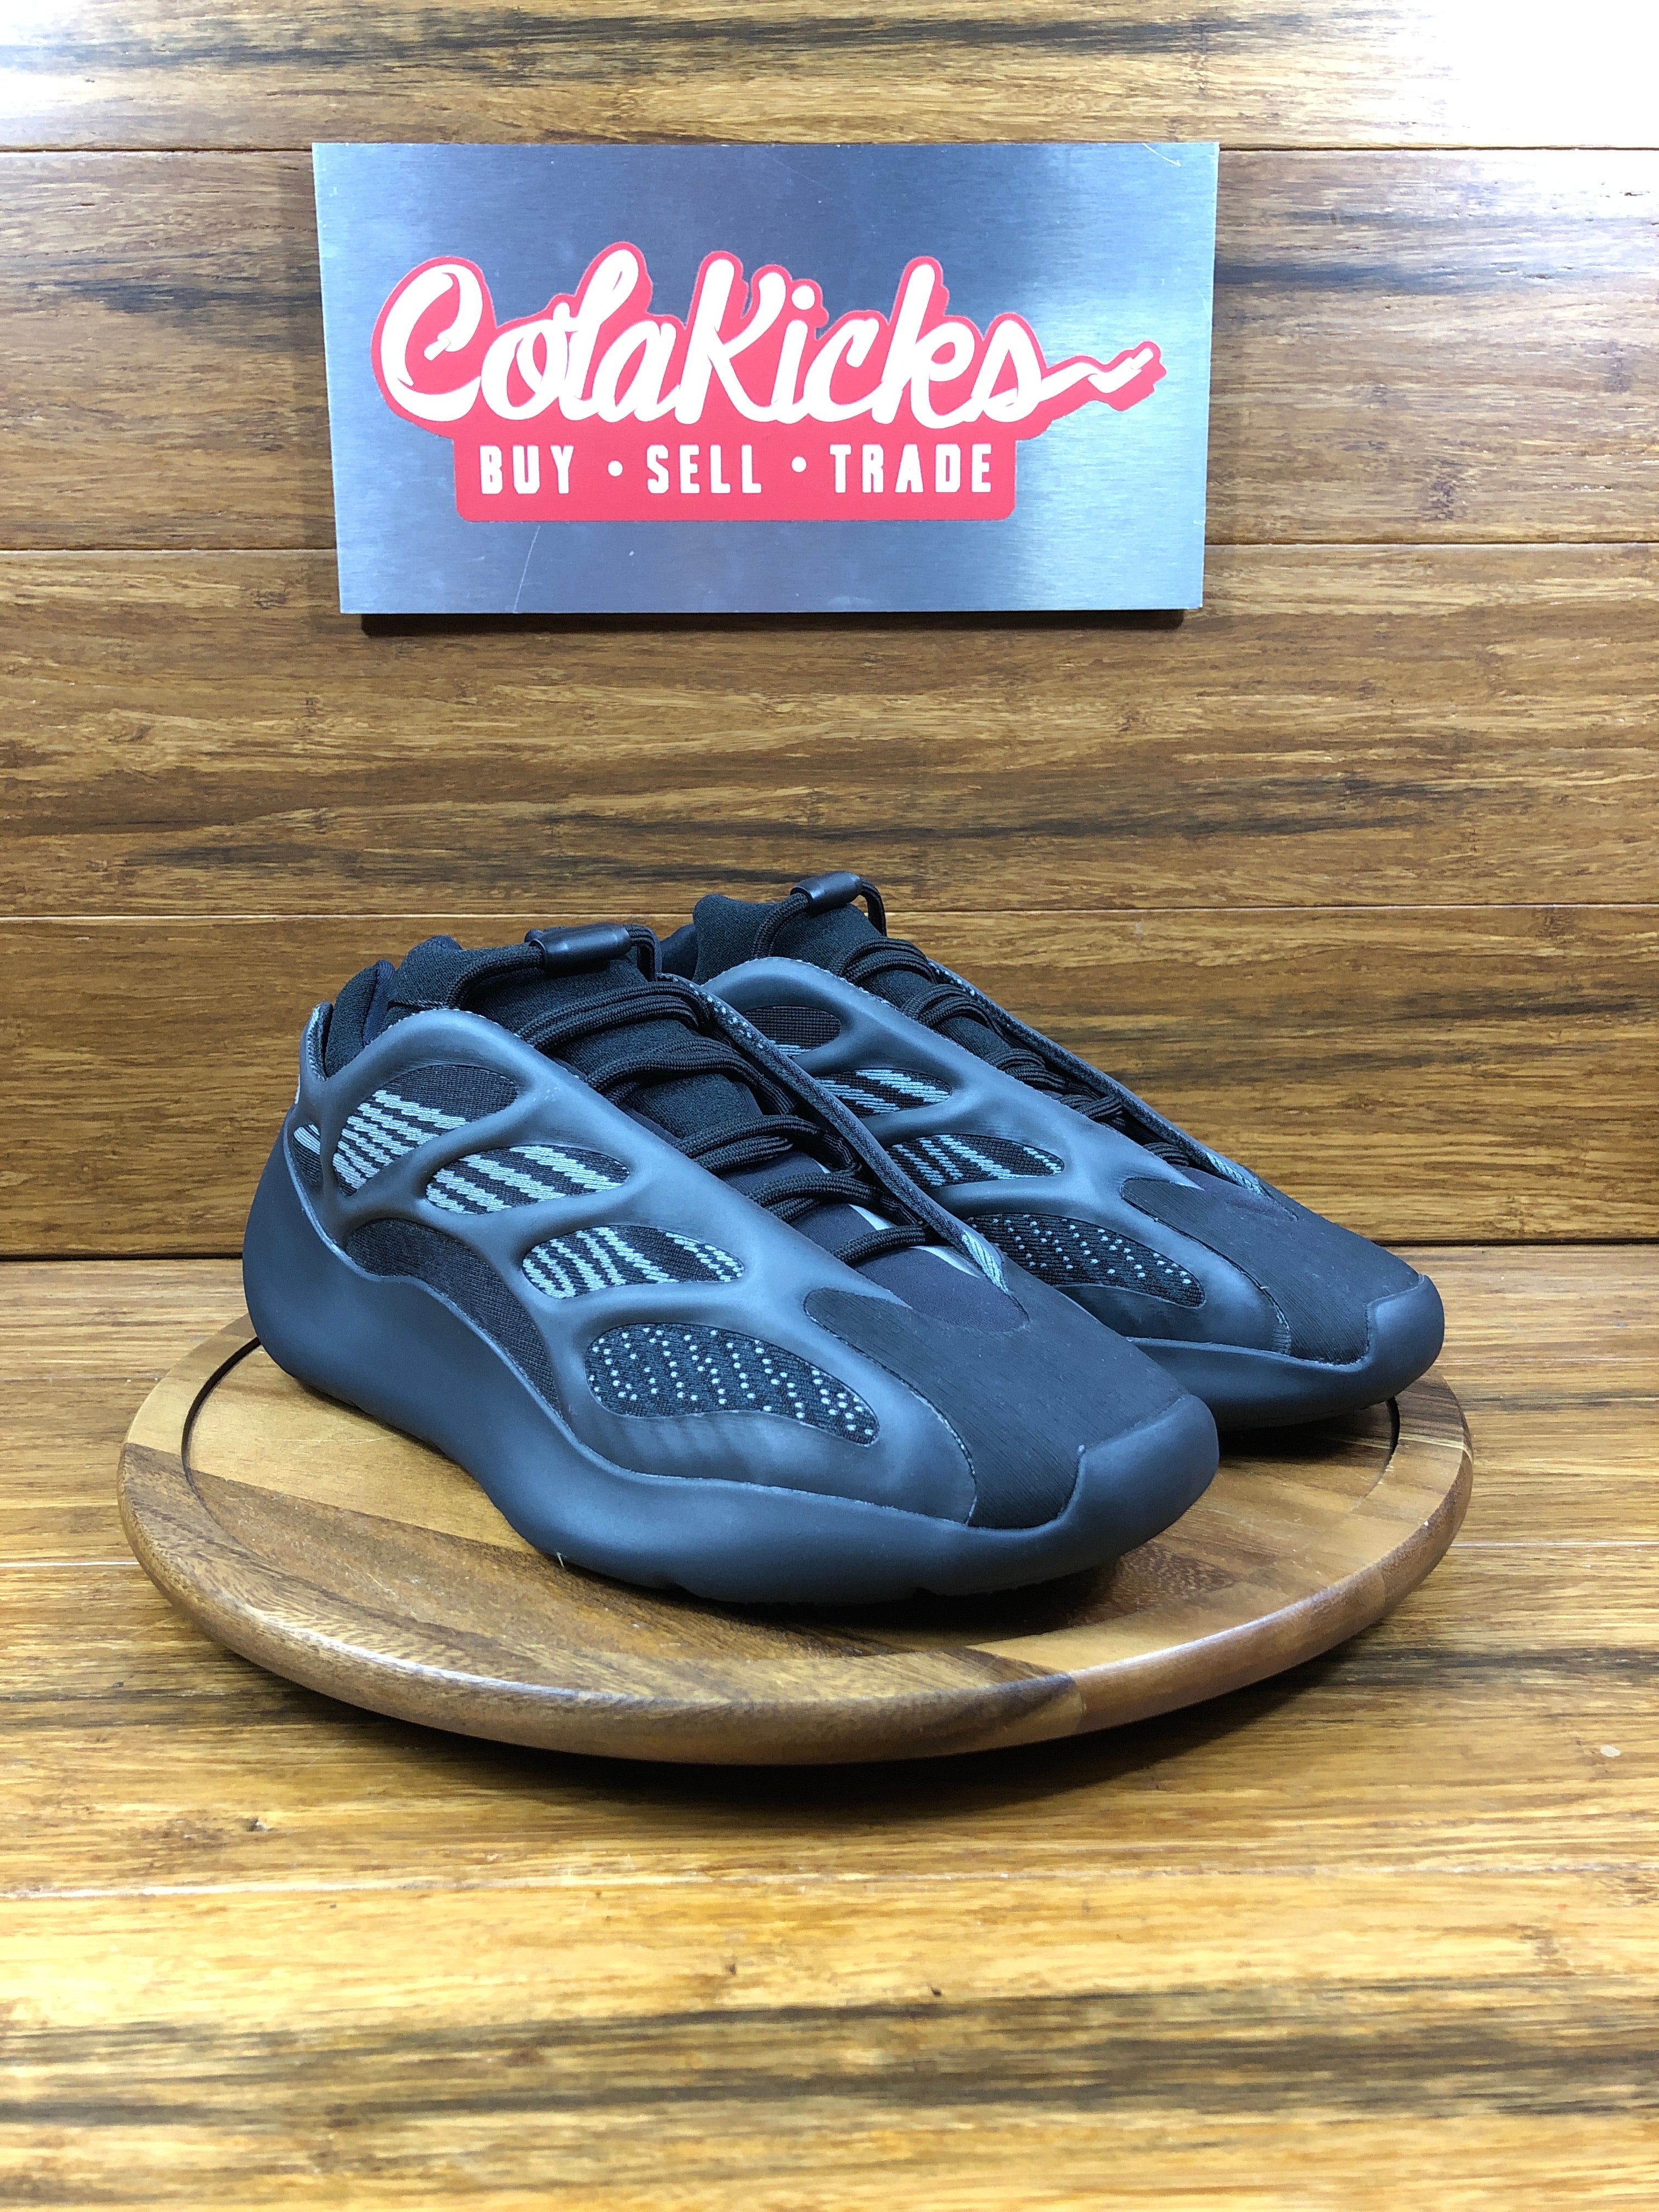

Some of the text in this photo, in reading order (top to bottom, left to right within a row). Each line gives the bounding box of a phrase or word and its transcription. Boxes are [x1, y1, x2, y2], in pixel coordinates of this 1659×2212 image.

[379, 249, 1154, 429] ColaKicks
[479, 444, 993, 494] BUY SELL TRADE
